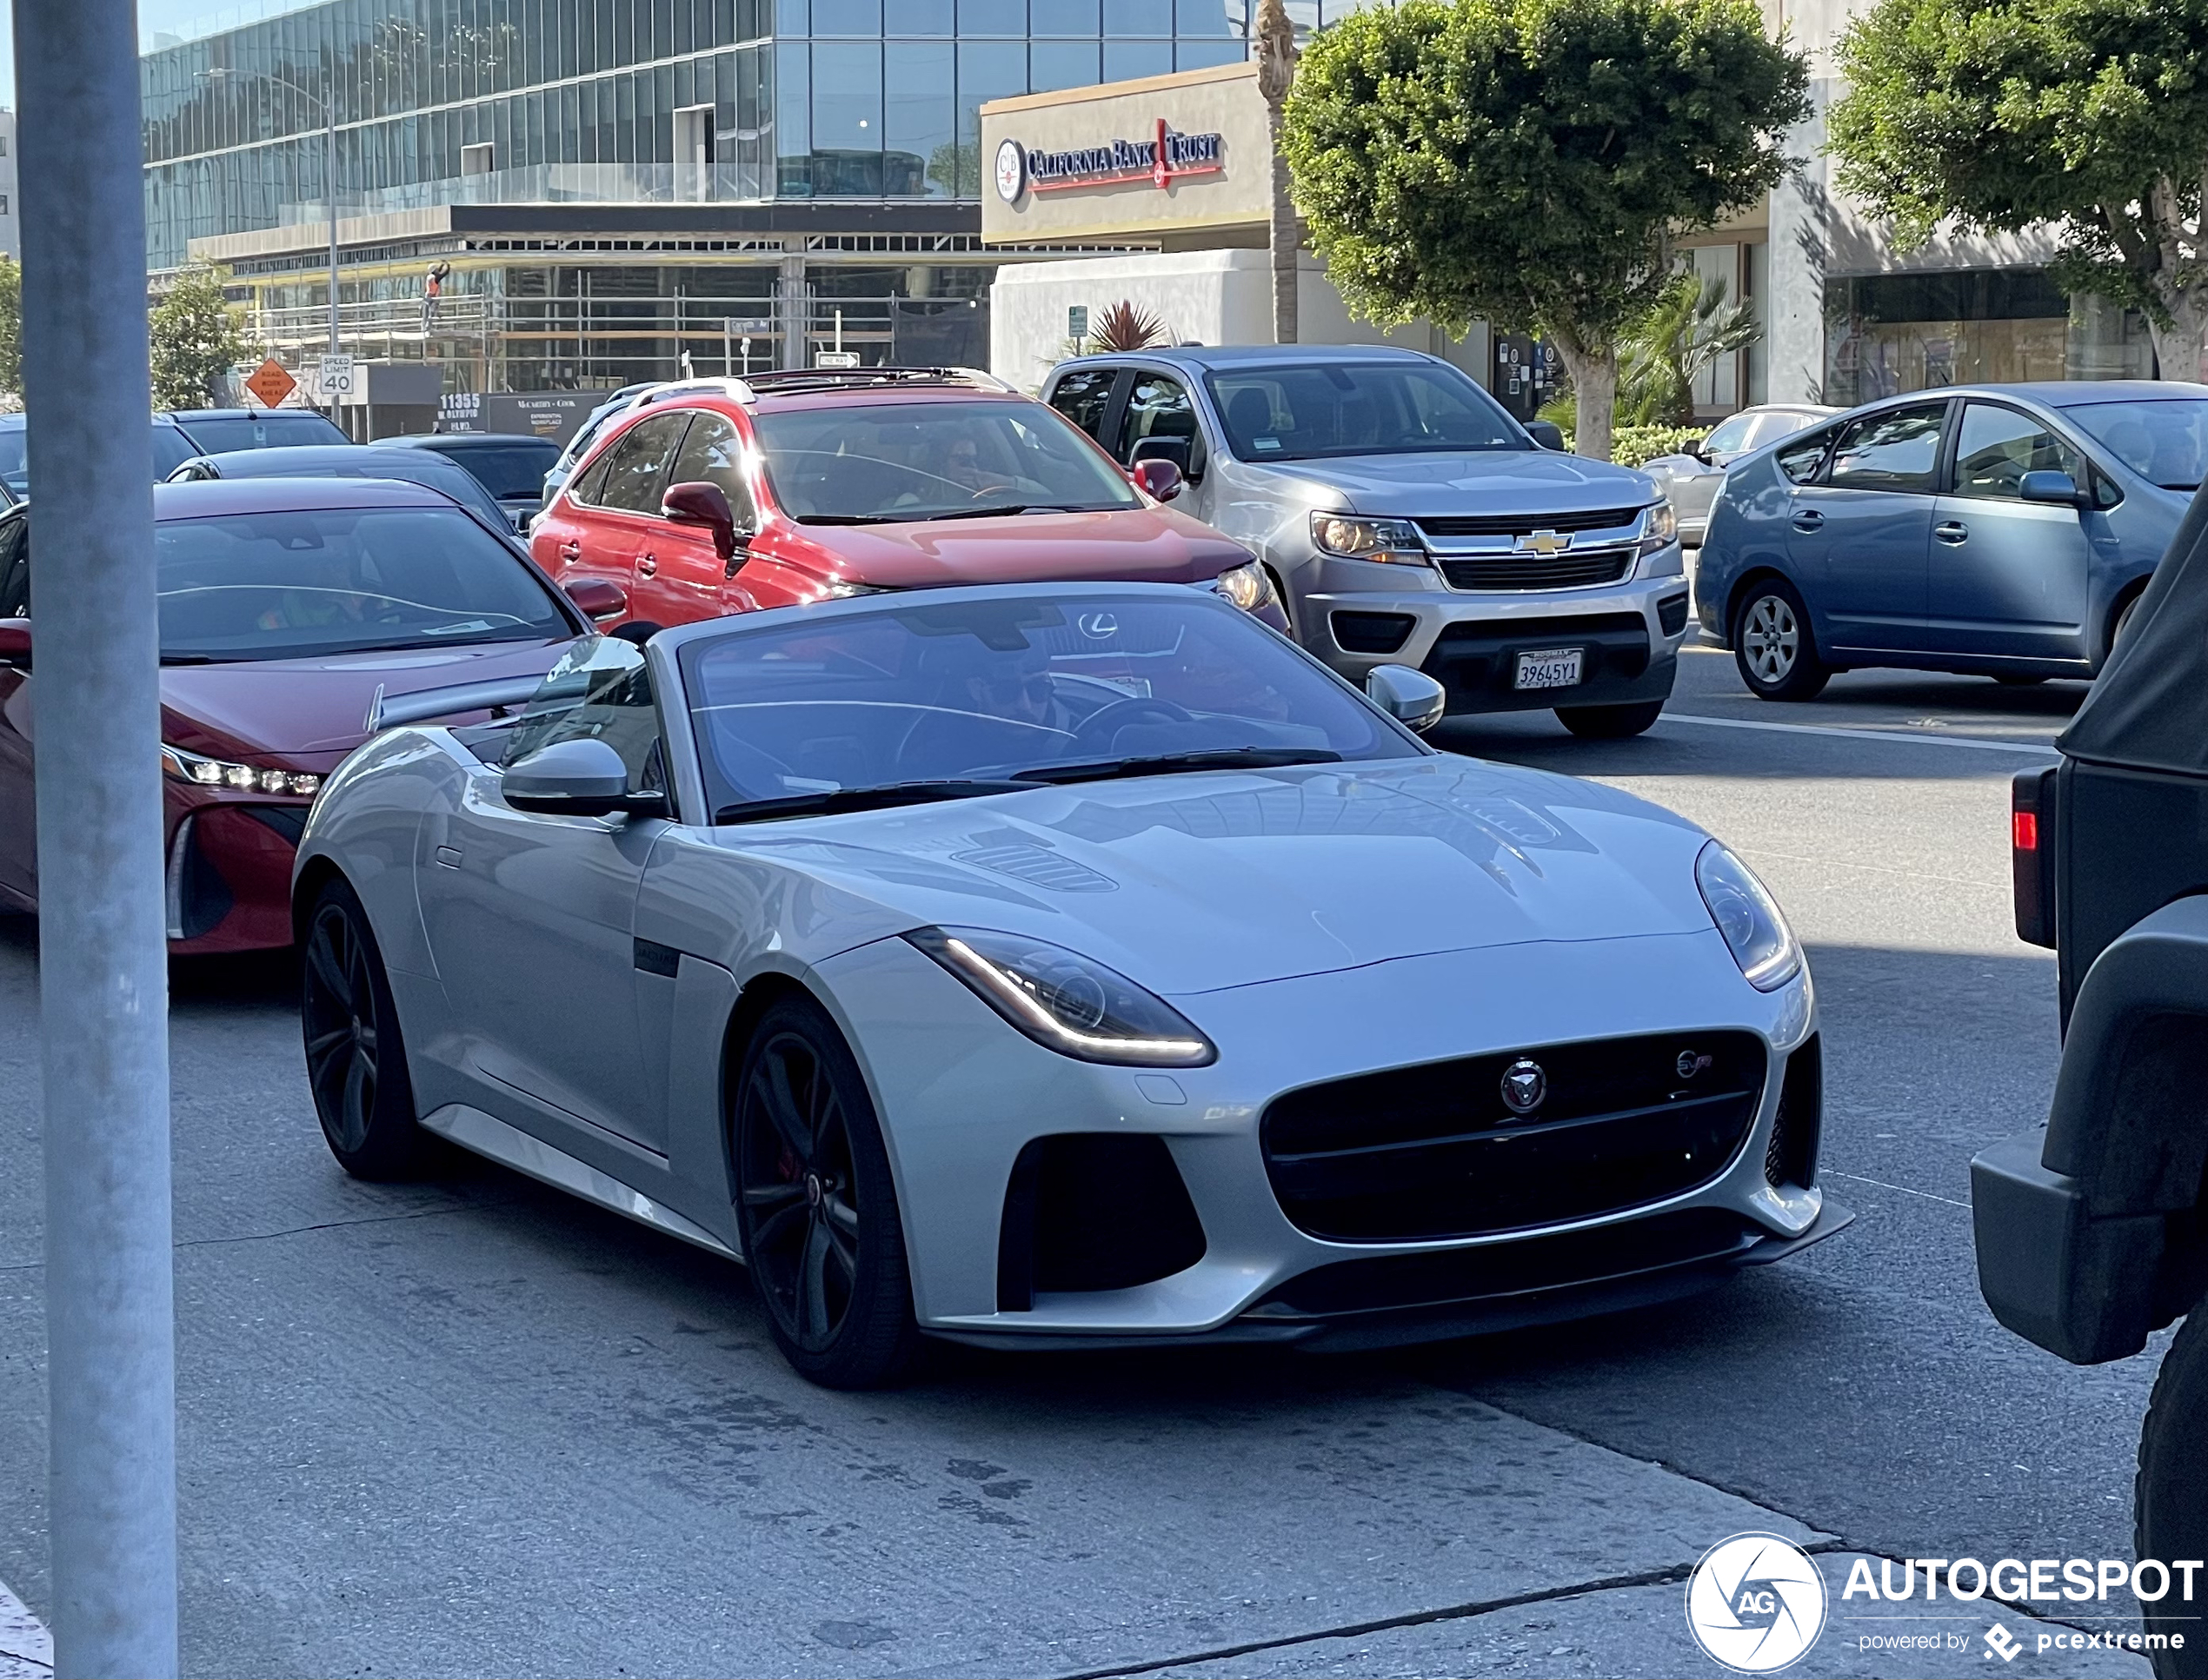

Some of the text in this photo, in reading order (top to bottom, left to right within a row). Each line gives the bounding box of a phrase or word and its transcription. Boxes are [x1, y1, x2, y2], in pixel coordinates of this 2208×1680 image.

[1027, 149, 1108, 179] CALIFORNIA
[1111, 140, 1154, 169] BANK
[1166, 133, 1217, 163] TRUST
[324, 375, 349, 390] 40
[440, 393, 481, 409] 11355
[446, 408, 478, 419] OLYMPIC
[1520, 662, 1576, 683] 39645Y1
